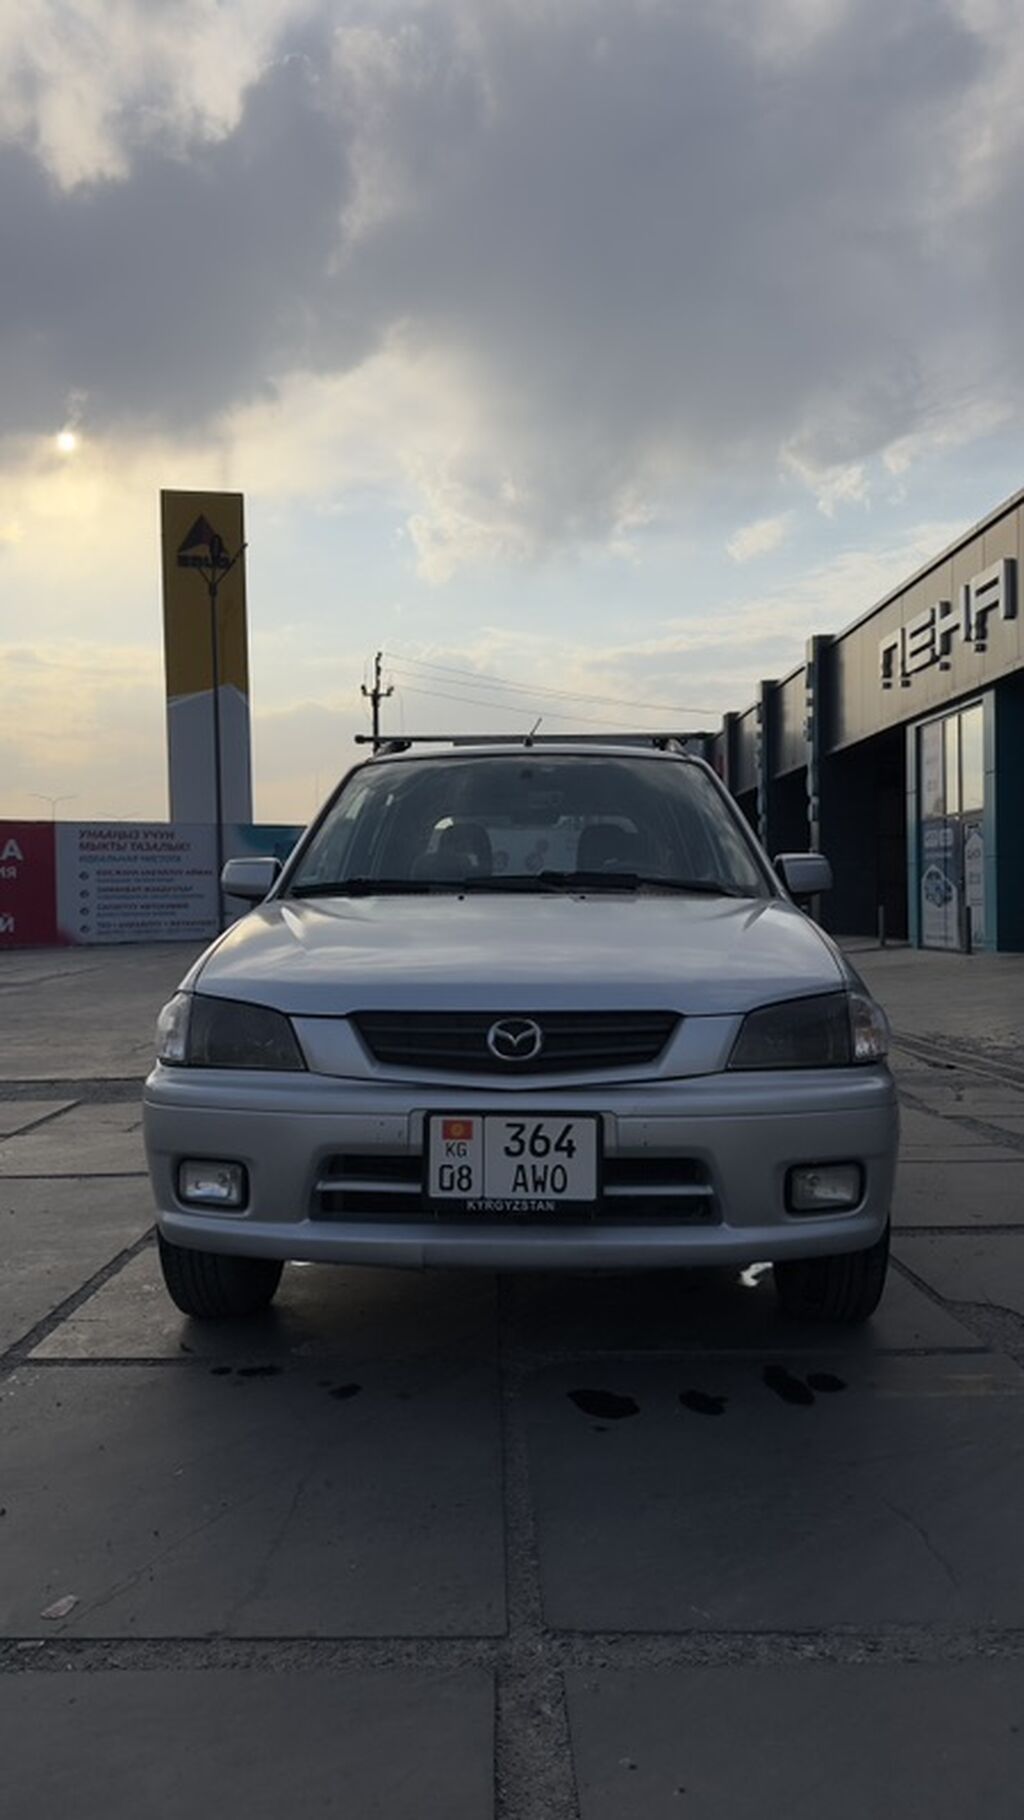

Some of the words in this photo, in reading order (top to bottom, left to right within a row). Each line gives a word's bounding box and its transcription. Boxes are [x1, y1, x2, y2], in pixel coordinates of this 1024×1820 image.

[879, 557, 1017, 689] ПЕНА
[445, 1142, 468, 1158] KG
[504, 1123, 576, 1158] 364
[439, 1164, 473, 1192] 08
[466, 1200, 556, 1212] KYRGYZSTAN
